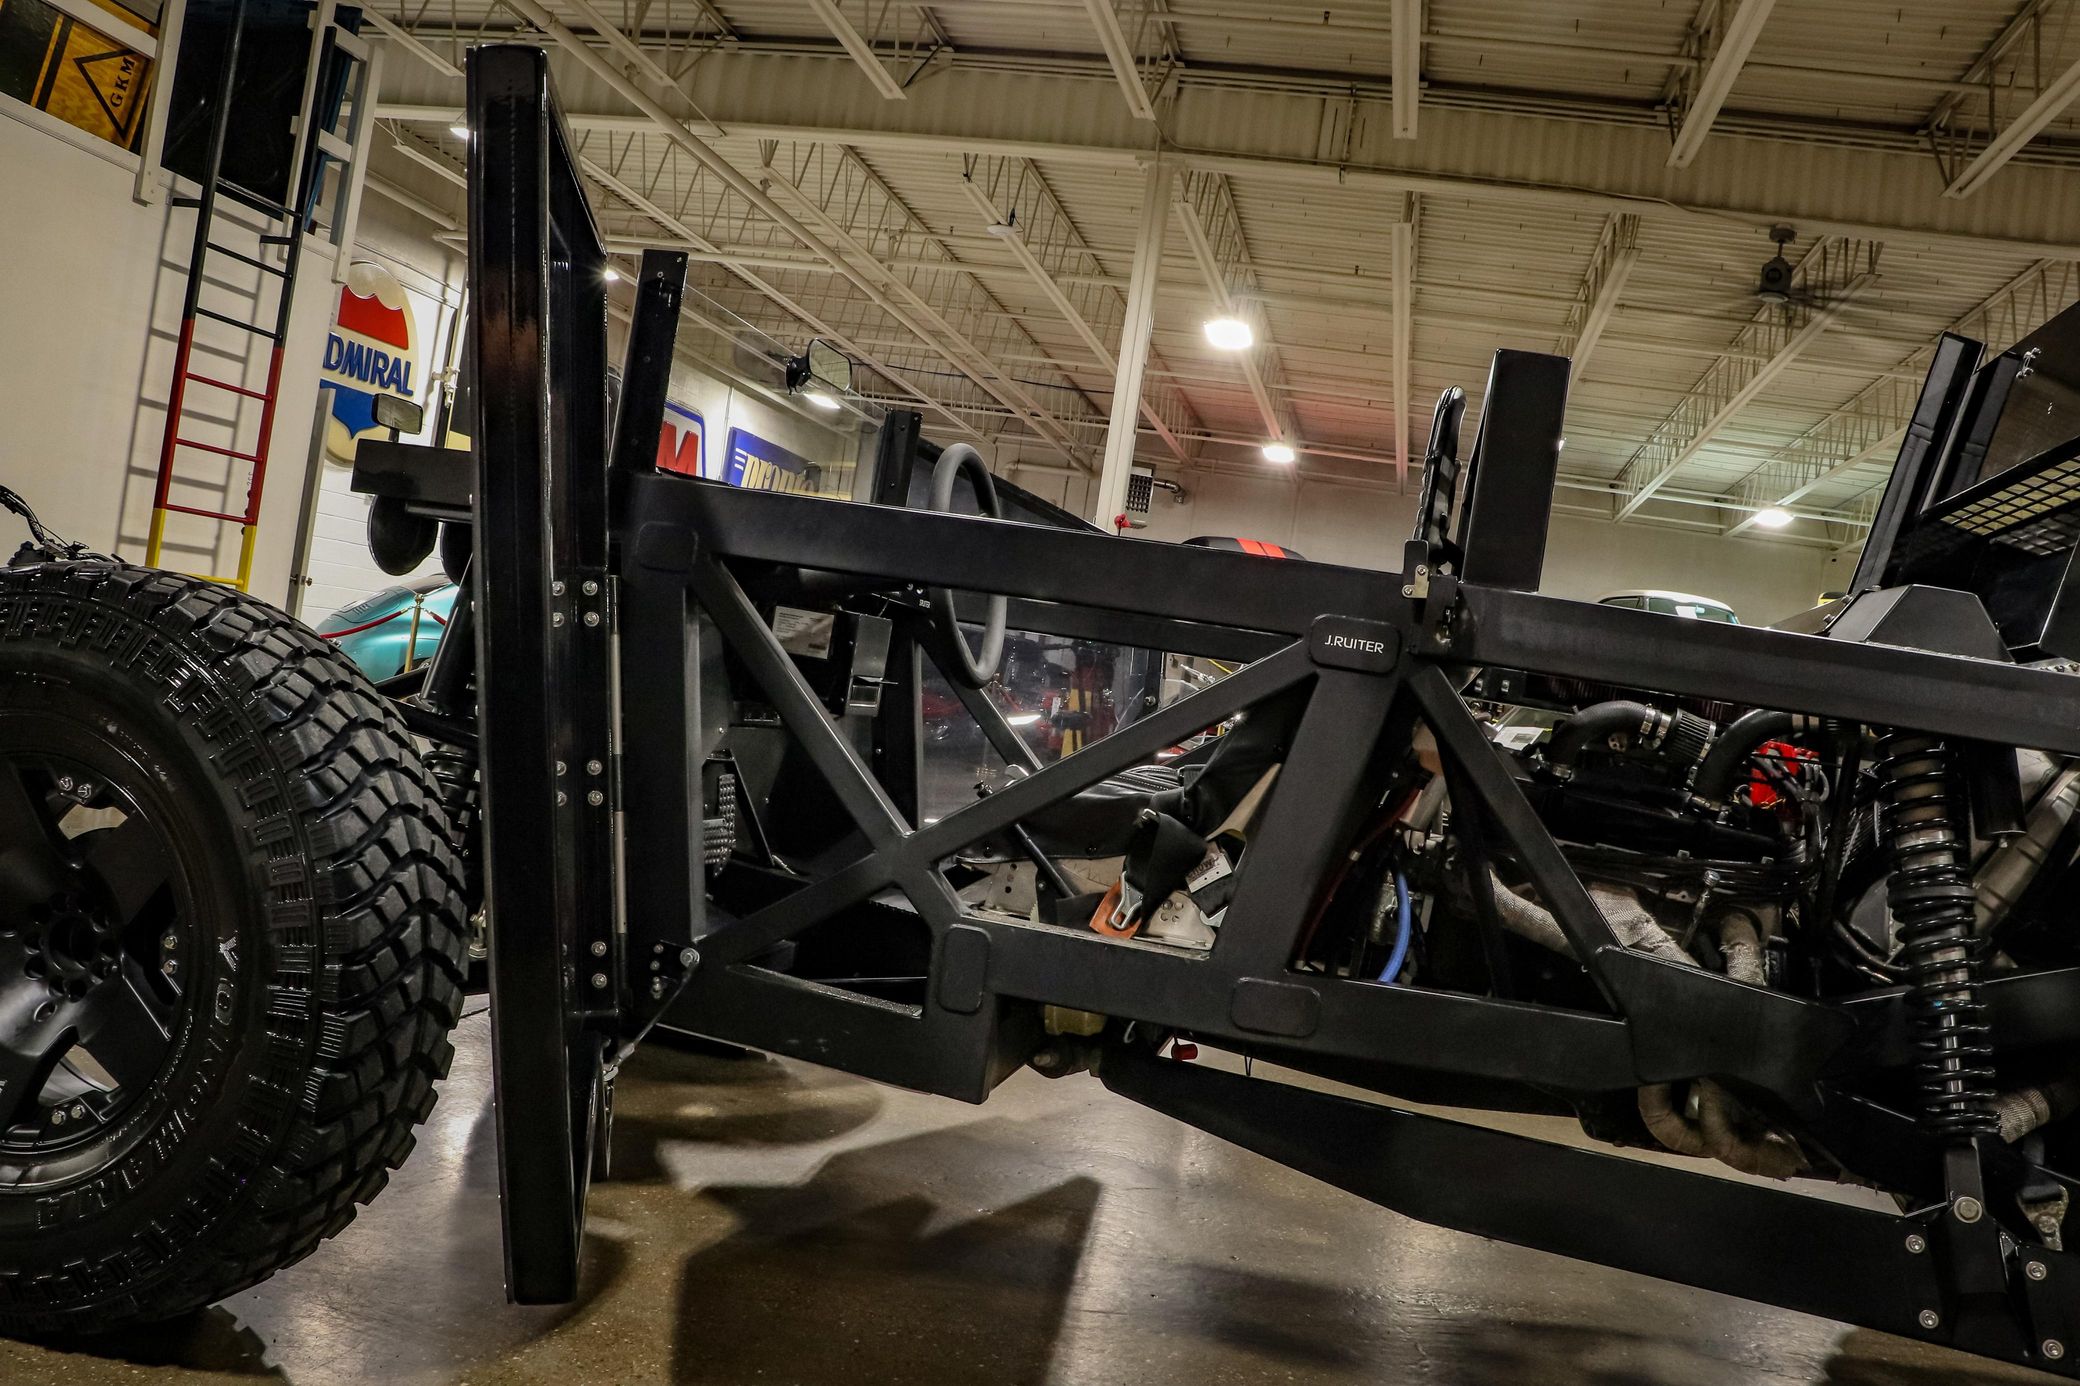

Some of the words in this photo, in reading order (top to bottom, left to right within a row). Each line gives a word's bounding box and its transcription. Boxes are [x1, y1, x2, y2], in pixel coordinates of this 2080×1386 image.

[110, 57, 135, 107] GKM
[323, 331, 413, 396] DMIRAL
[1324, 634, 1385, 654] J.RUITER
